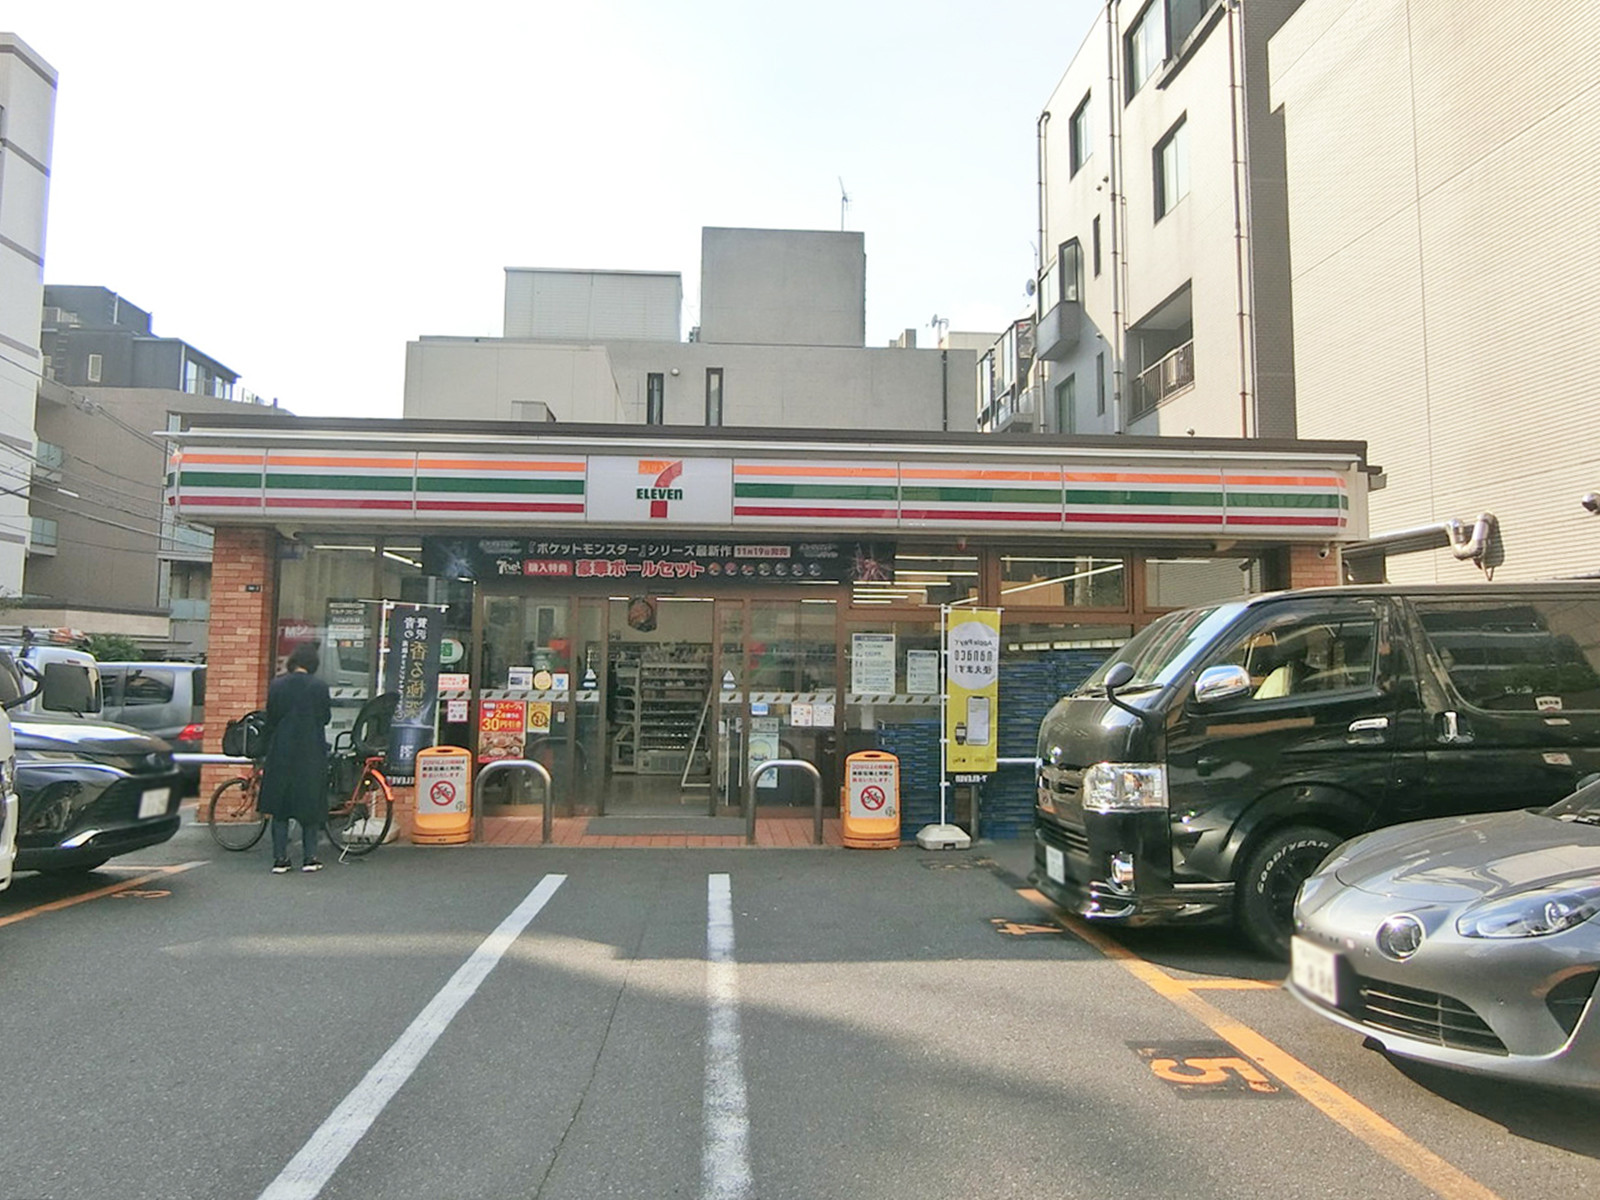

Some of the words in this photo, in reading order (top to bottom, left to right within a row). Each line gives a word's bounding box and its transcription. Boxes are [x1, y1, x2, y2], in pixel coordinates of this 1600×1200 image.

[637, 459, 683, 518] 7
[1257, 840, 1330, 895] GOODYEAR
[1150, 1057, 1280, 1093] 5
